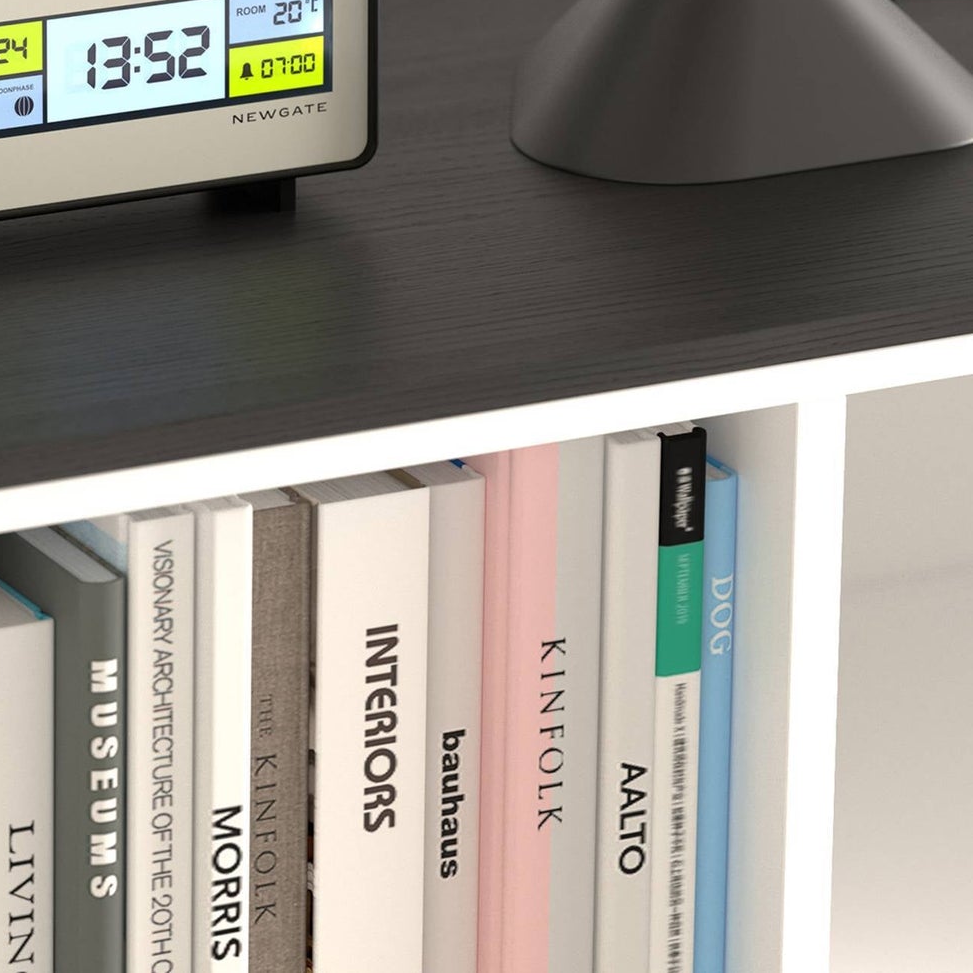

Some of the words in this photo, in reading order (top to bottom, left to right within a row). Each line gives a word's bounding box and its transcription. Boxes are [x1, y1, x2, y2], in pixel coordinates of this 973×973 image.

[87, 25, 211, 89] 13:52
[236, 4, 267, 16] ROOM
[232, 102, 327, 124] NEWGATE
[152, 539, 173, 644] VISIONARY
[710, 574, 734, 656] DOG
[151, 648, 173, 809] ARCHITECTURE
[258, 694, 272, 739] THE
[363, 623, 398, 833] INTERIORS
[537, 637, 566, 831] KINFOLK
[90, 659, 118, 899] MUSEUMS
[151, 813, 173, 842] OF
[439, 729, 467, 879] bauhaus
[618, 762, 649, 876] AALTO
[151, 844, 173, 890] THE
[211, 805, 242, 961] MORRIS
[252, 753, 278, 925] KINFOLK
[8, 820, 35, 973] LIVIN
[151, 893, 173, 954] 20TH
